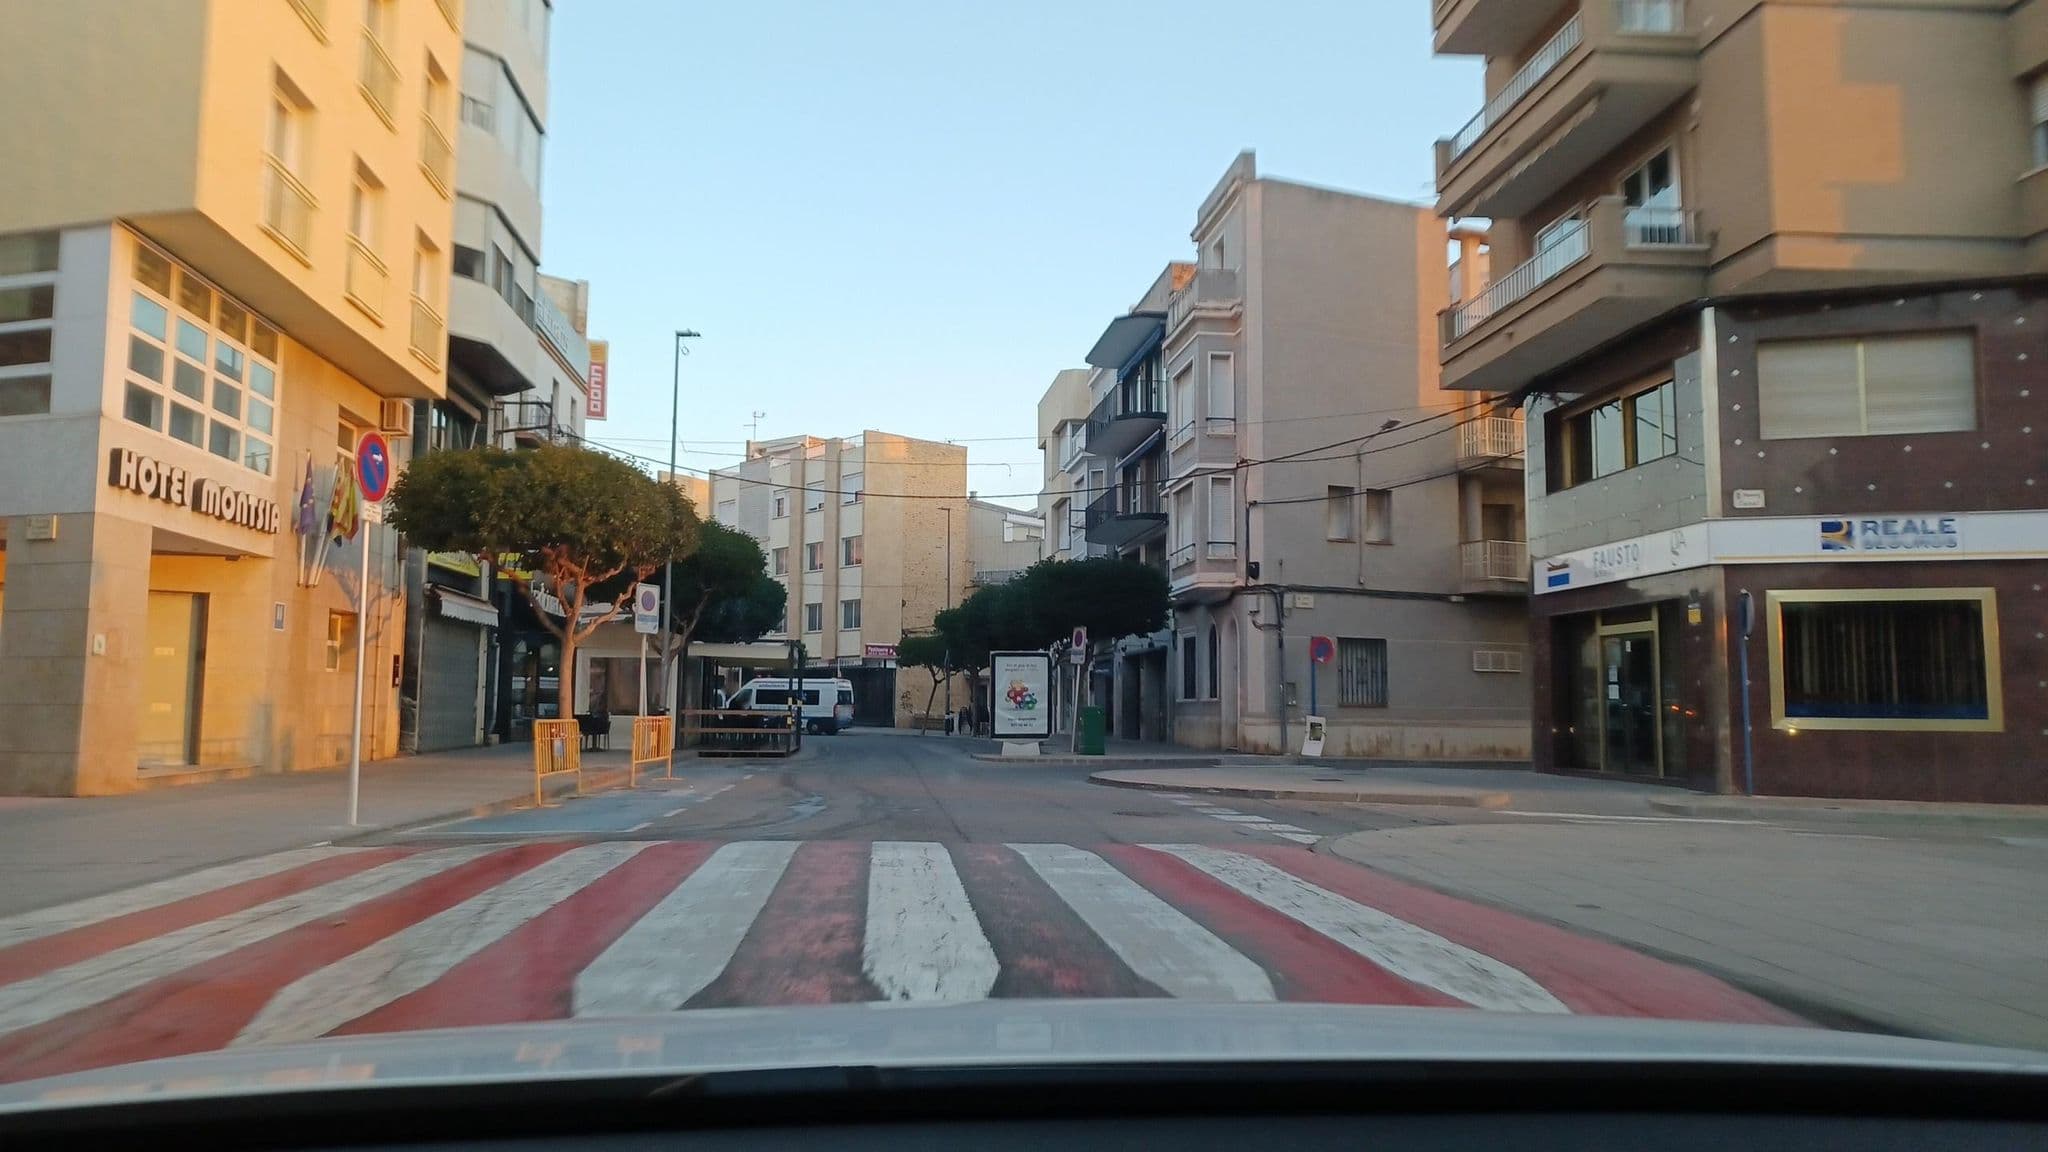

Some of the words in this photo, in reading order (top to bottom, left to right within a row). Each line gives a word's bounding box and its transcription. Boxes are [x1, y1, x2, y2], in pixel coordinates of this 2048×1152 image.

[112, 448, 192, 508] HOTEL
[194, 478, 281, 534] MONTSIA
[1861, 518, 1958, 535] REALE
[1593, 543, 1640, 570] FAUSTO
